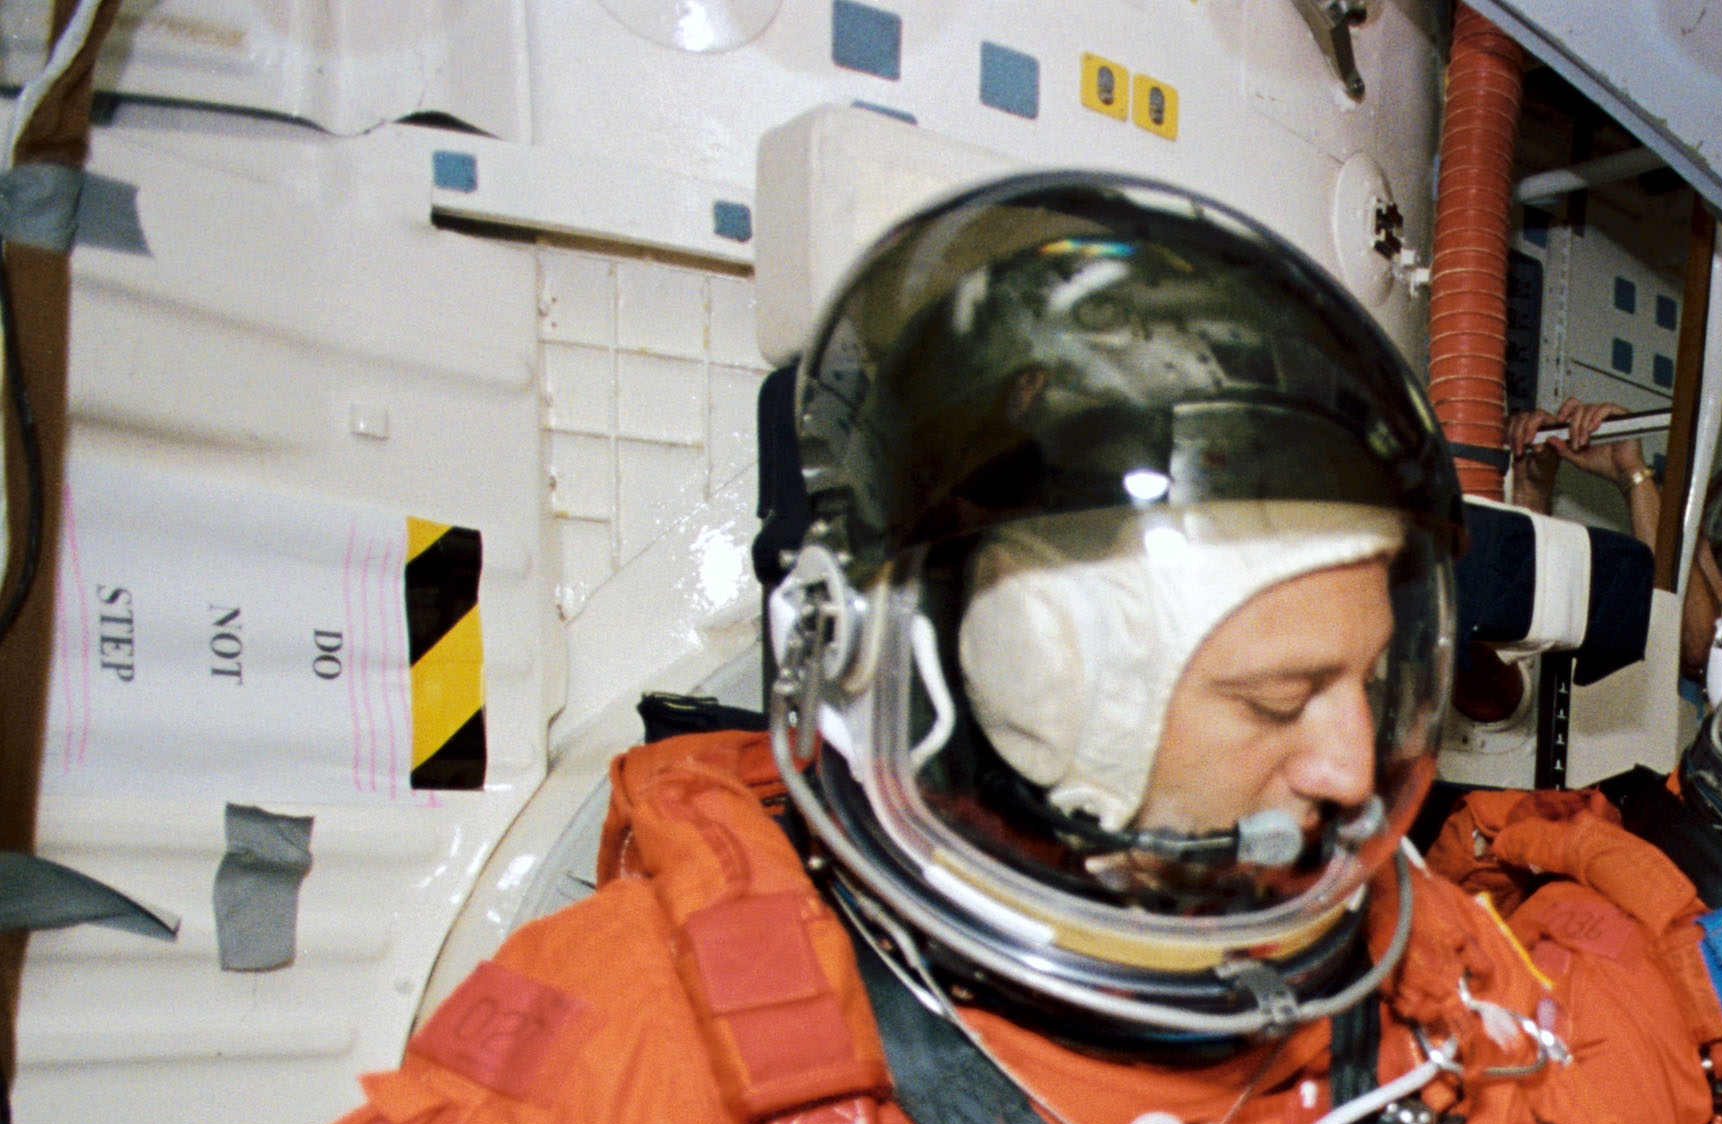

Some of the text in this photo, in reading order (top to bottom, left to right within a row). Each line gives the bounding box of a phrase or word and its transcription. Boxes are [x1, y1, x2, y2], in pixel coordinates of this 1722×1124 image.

[97, 584, 135, 682] STEP
[209, 604, 243, 686] NOT
[312, 629, 343, 680] DO
